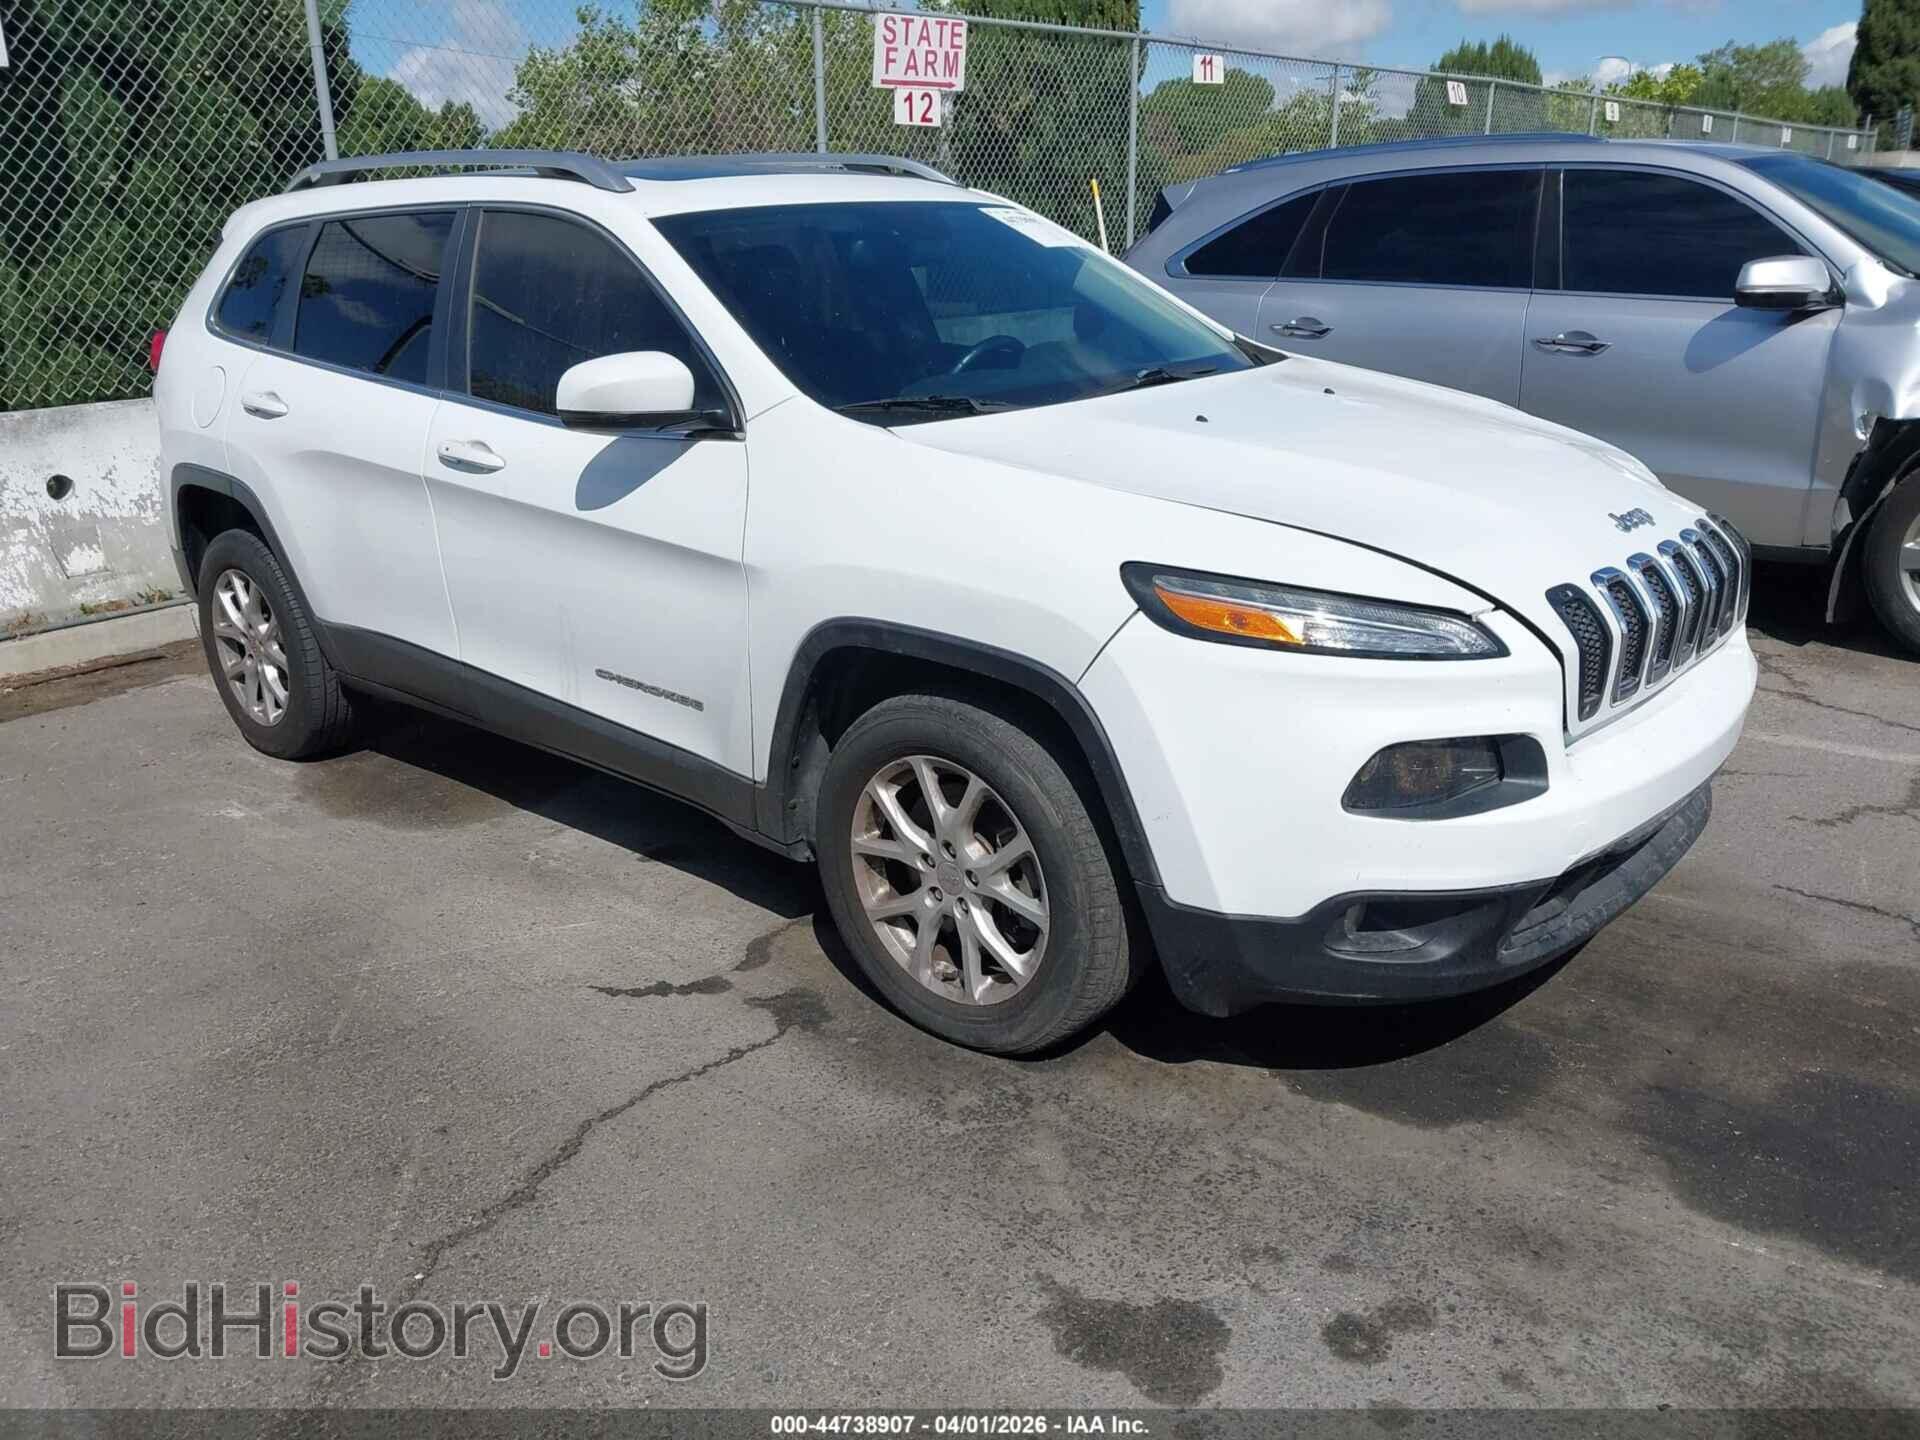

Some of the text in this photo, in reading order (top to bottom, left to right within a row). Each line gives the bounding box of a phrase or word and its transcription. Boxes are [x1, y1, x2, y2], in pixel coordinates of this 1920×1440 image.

[882, 15, 964, 50] STATE
[884, 46, 960, 79] FARM
[1200, 55, 1214, 81] 11
[903, 91, 934, 123] 12
[1451, 83, 1464, 103] 10
